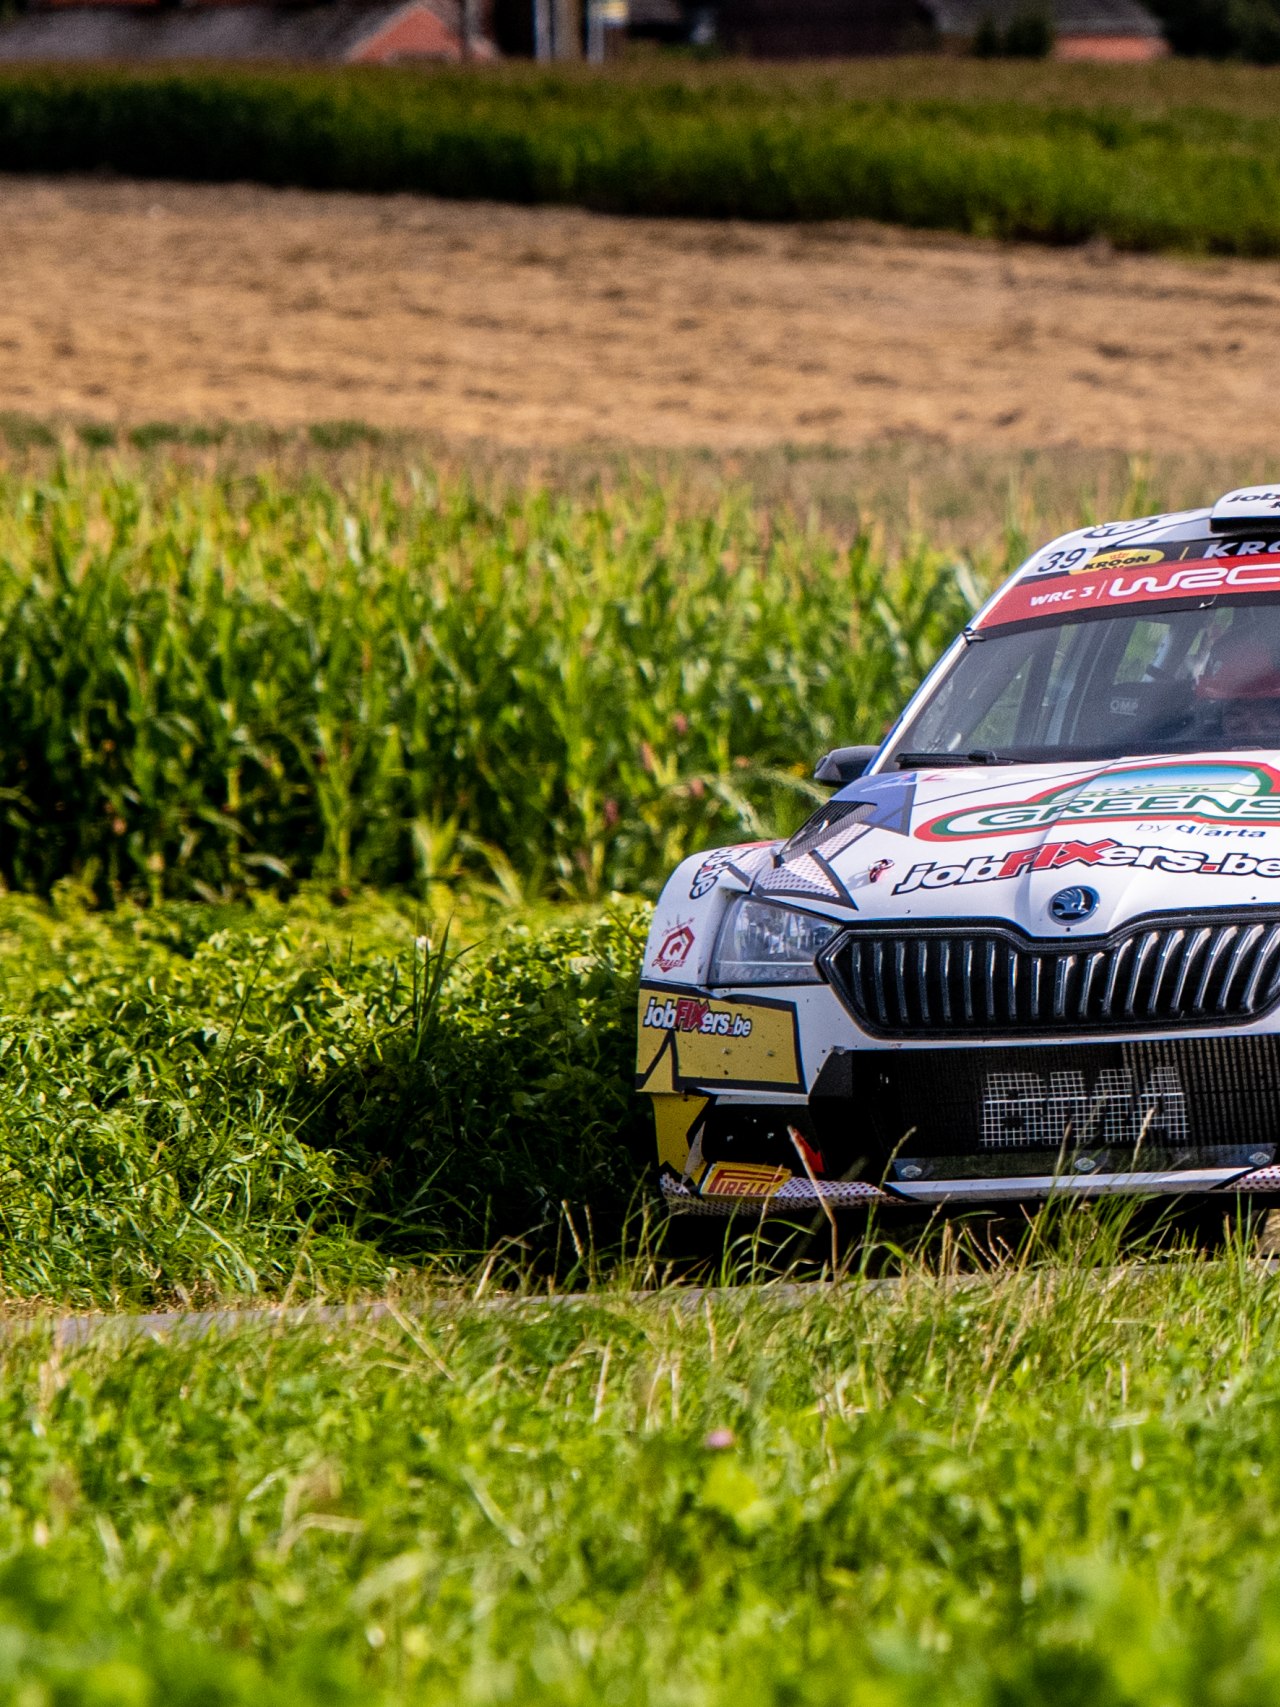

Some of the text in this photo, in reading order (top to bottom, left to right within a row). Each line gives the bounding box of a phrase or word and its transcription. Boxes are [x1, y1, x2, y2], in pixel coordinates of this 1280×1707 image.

[1037, 548, 1087, 572] 39
[1082, 555, 1151, 570] KROON
[1030, 588, 1076, 607] WRC
[1079, 586, 1095, 599] 3
[643, 997, 753, 1038] jobFIXers.be
[709, 1169, 783, 1194] PIRELLI
